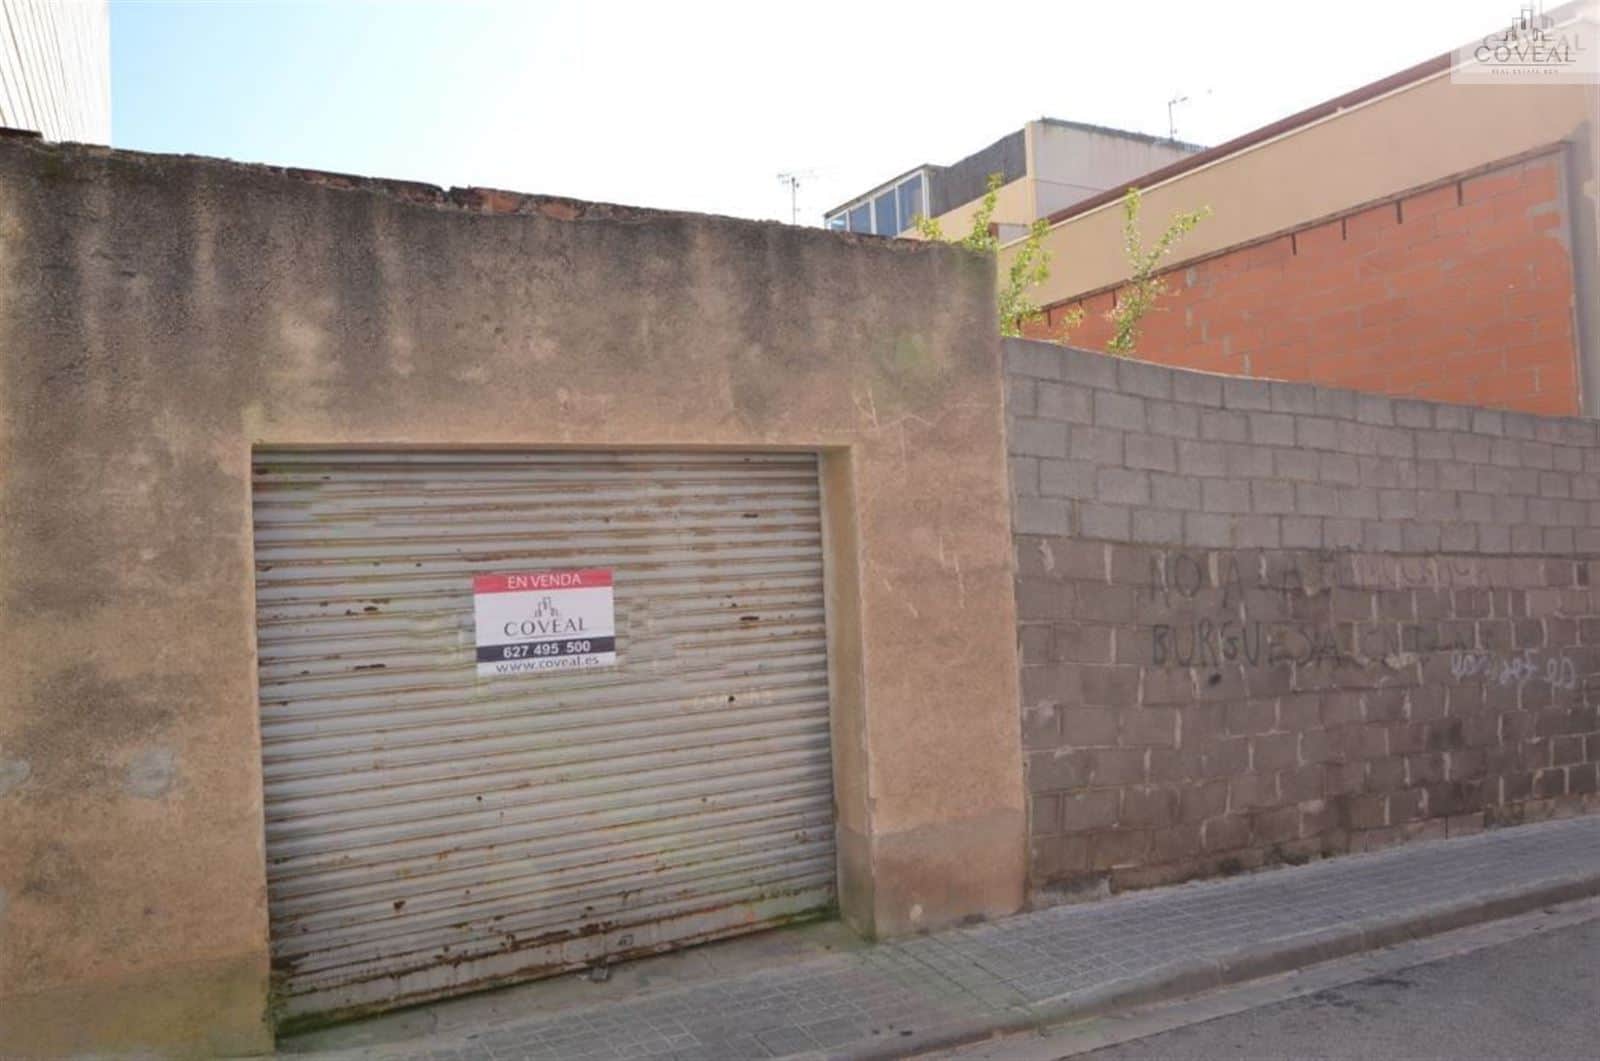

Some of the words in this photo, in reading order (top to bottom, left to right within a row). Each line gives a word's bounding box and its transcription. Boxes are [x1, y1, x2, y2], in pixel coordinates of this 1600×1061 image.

[507, 575, 528, 590] EN
[530, 572, 582, 588] VENDA
[503, 616, 589, 637] COVEAL
[502, 645, 529, 659] 627
[533, 642, 560, 656] 495
[566, 639, 592, 653] 500
[495, 655, 600, 673] www.coveal.es
